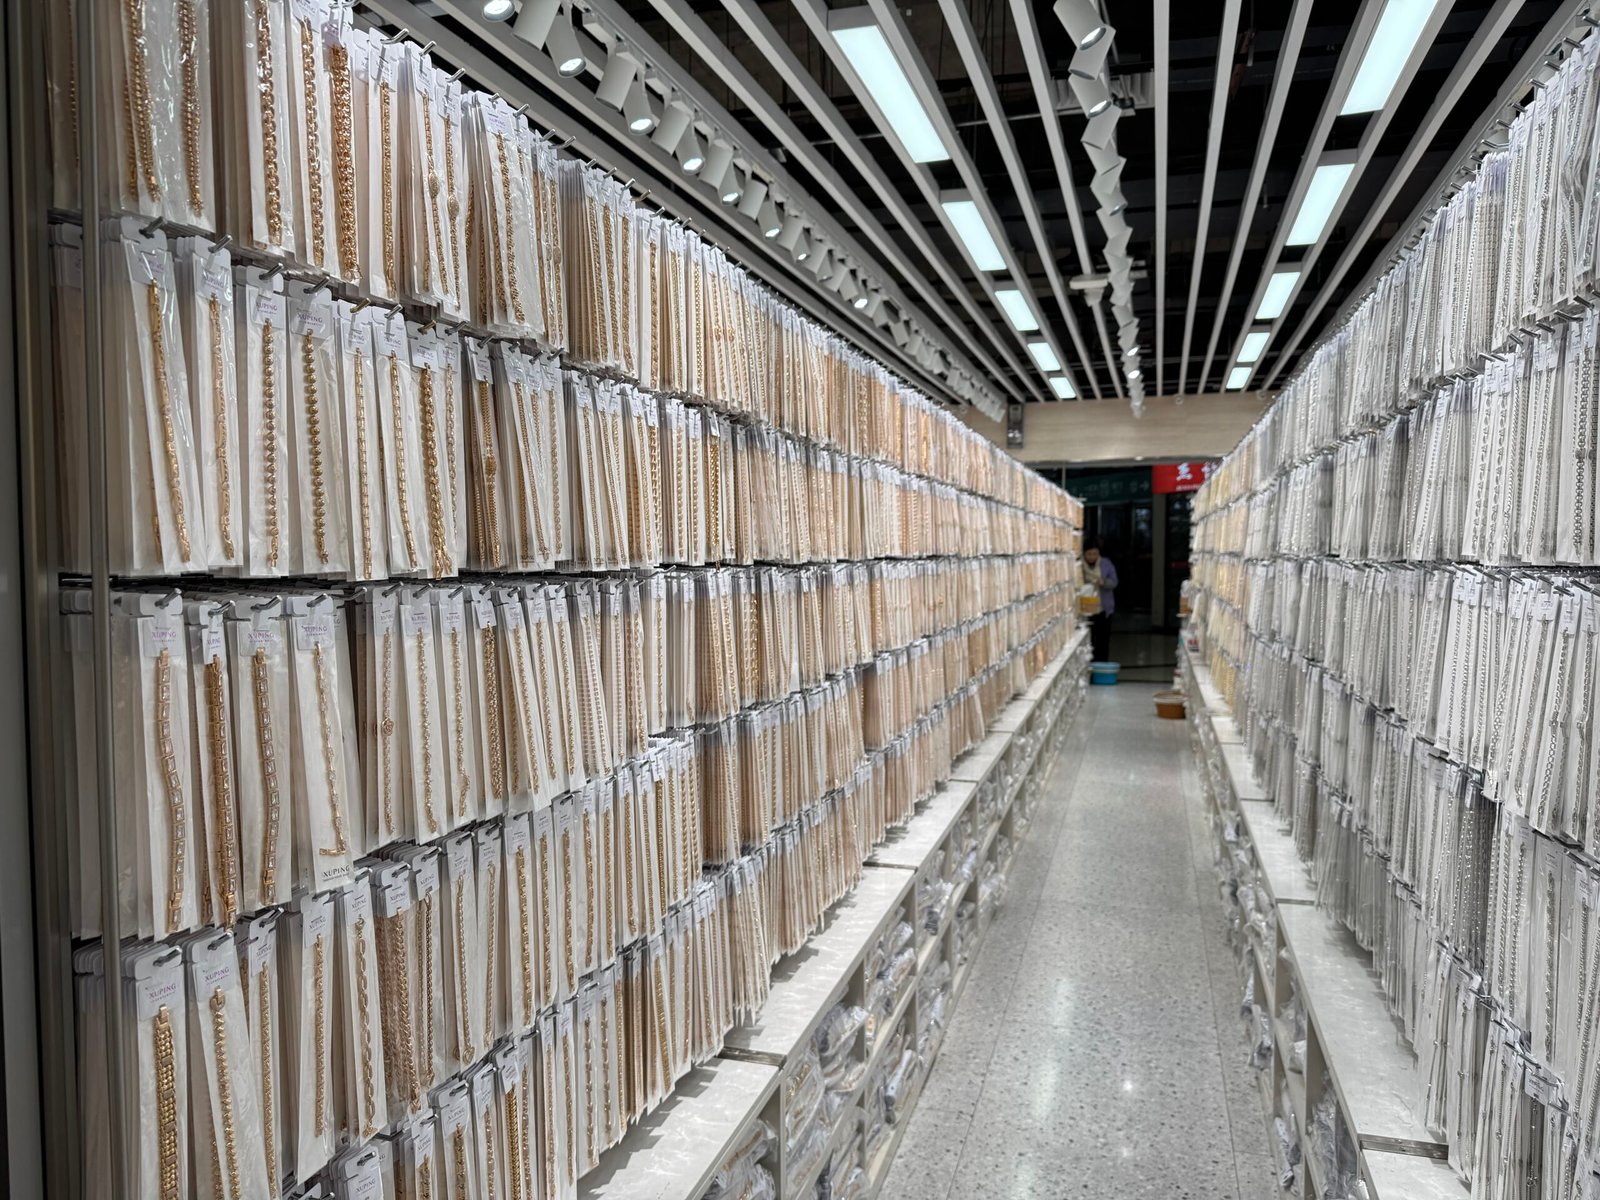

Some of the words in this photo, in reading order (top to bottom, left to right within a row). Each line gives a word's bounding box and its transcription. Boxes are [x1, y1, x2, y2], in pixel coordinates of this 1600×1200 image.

[323, 865, 350, 878] XUPING
[204, 967, 230, 982] XUPING
[149, 983, 177, 999] XUPING
[356, 1179, 377, 1193] XUPING
